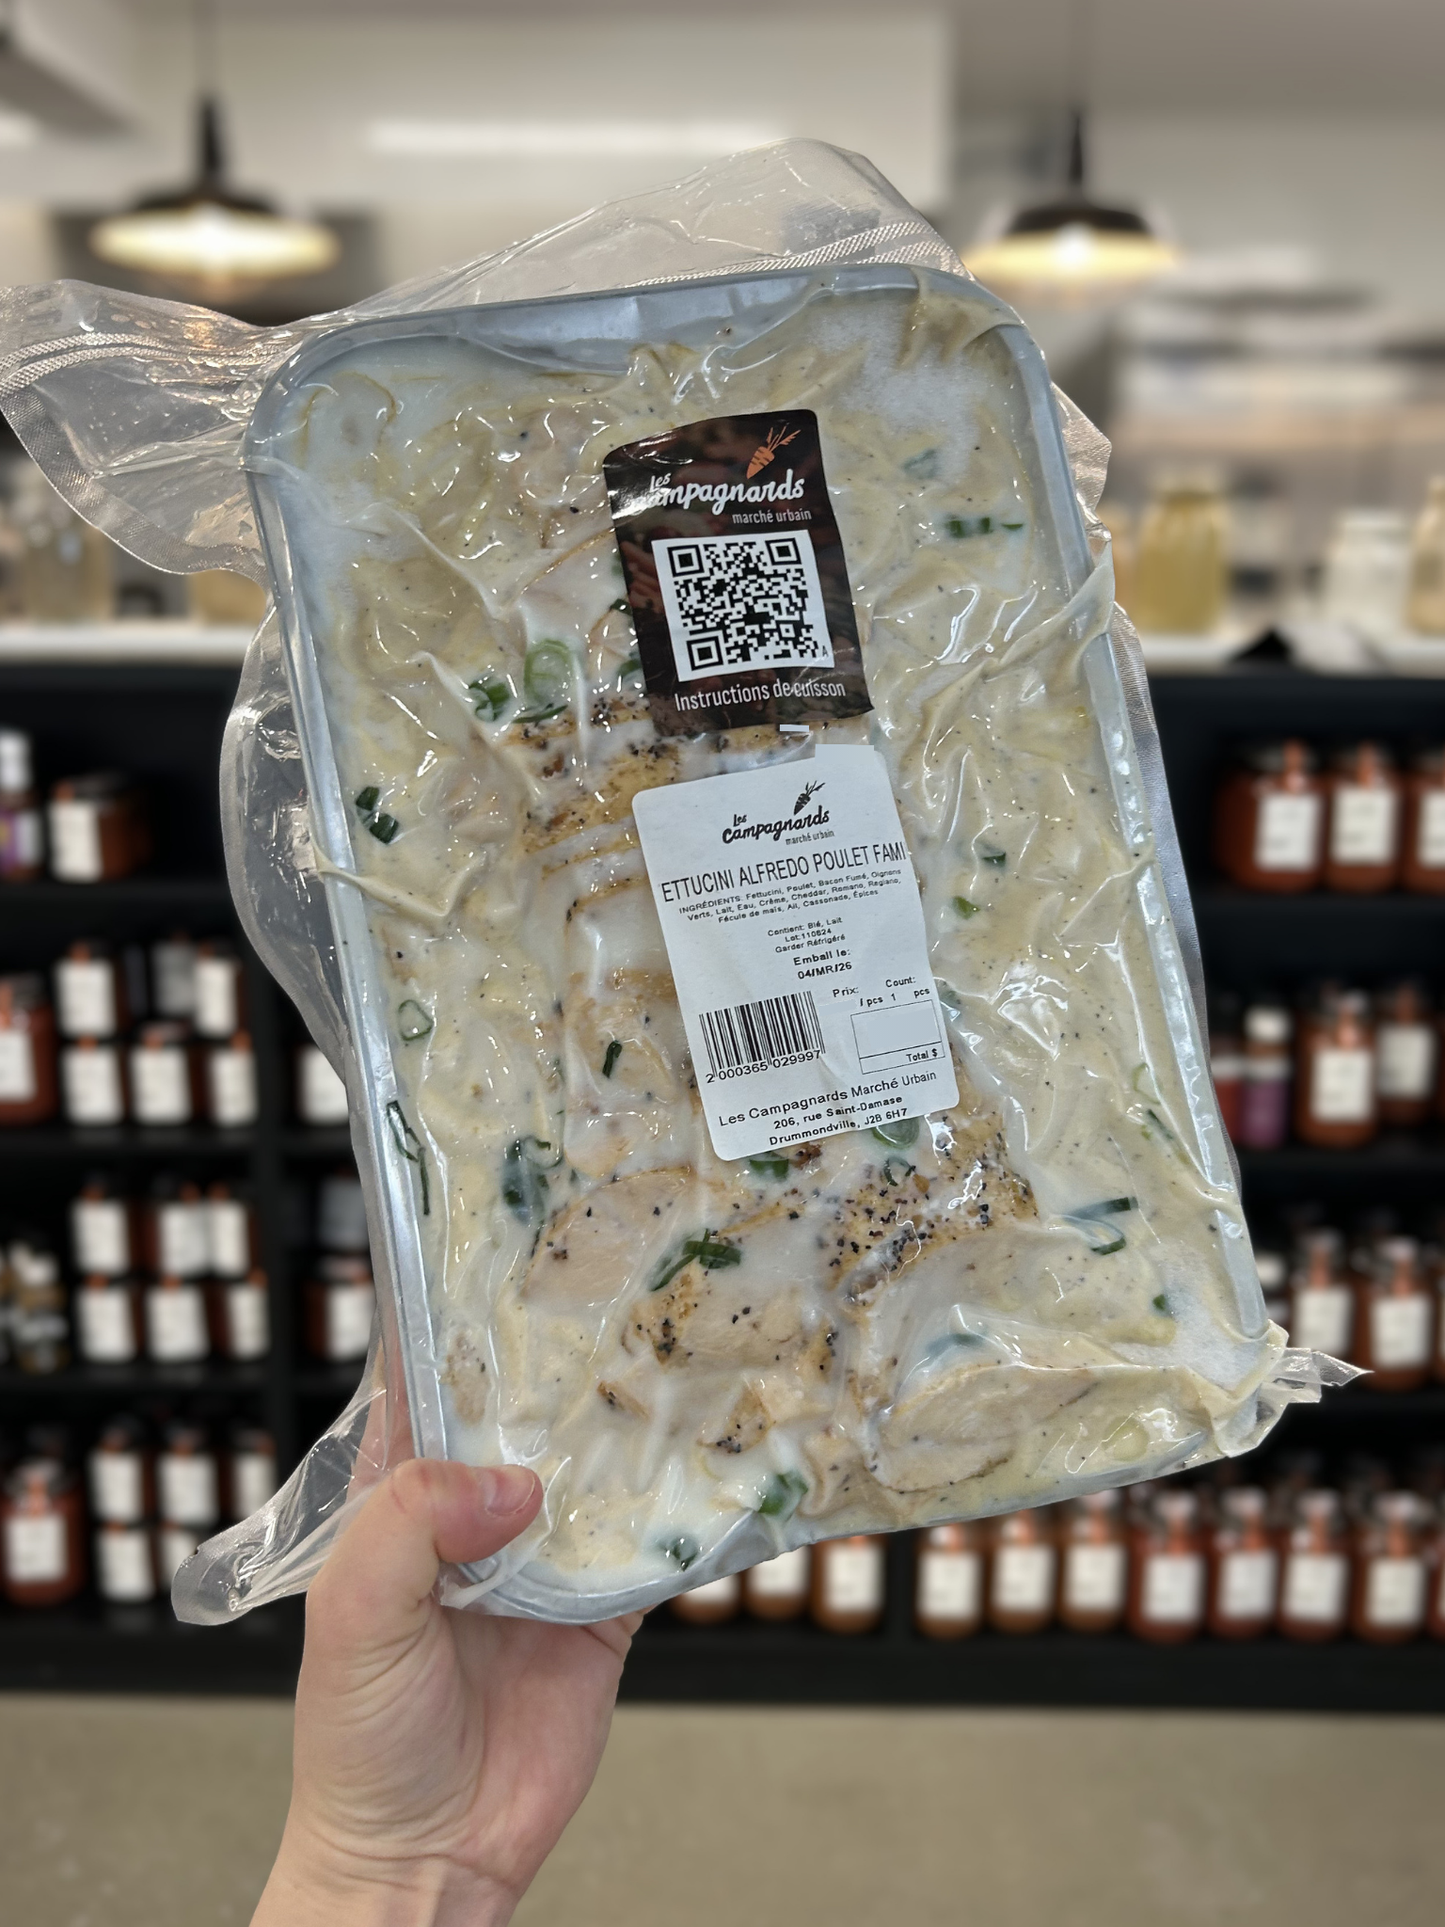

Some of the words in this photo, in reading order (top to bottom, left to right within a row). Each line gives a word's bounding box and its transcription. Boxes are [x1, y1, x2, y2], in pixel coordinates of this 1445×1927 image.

[630, 468, 805, 516] ampagnards
[650, 473, 671, 492] Les
[732, 509, 772, 524] marché
[776, 508, 812, 523] urbain
[674, 683, 770, 712] Instructions
[773, 678, 792, 698] de
[794, 678, 847, 698] cuisson
[722, 805, 830, 844] Campagnards
[733, 814, 747, 827] Les
[785, 832, 812, 845] marché
[812, 829, 835, 840] urbain
[740, 856, 809, 887] ALFREDO
[812, 846, 869, 873] POULET
[872, 841, 907, 864] FAMI
[746, 888, 784, 900] Fettucini,
[787, 882, 816, 892] Poulet,
[818, 877, 844, 887] Bacon
[846, 873, 869, 882] Fumé,
[871, 869, 902, 878] Oignons
[687, 911, 713, 921] Verts,
[716, 906, 734, 915] Lait,
[737, 903, 756, 911] Eau,
[759, 896, 789, 907] Crème,
[791, 889, 829, 901] Cheddar,
[832, 882, 866, 893] Romano,
[868, 878, 901, 888] Regiano,
[718, 912, 747, 923] Fécule
[749, 910, 760, 918] de
[803, 893, 851, 907] Cassonade,
[853, 890, 879, 899] Épices
[767, 924, 805, 937] Contient:
[826, 917, 843, 926] Lait
[775, 942, 805, 953] Garder
[807, 934, 846, 948] Réfrigéré
[793, 951, 833, 966] Emball
[797, 961, 853, 979] 04/MR/26
[885, 976, 916, 988] Count:
[832, 986, 859, 998] Prix:
[866, 996, 884, 1007] pcs
[913, 988, 930, 999] pcs
[905, 1050, 930, 1062] Total
[931, 1048, 938, 1058] $
[705, 1073, 715, 1084] 2
[718, 1061, 768, 1081] 000365
[772, 1049, 821, 1069] 029997
[719, 1113, 746, 1127] Les
[749, 1090, 848, 1119] Campagnards
[851, 1078, 899, 1098] Marché
[901, 1070, 937, 1087] Urbain
[773, 1117, 800, 1130] 206,
[803, 1112, 822, 1123] rue
[826, 1096, 903, 1117] Saint-Damase
[769, 1121, 861, 1145] Drummondville,
[864, 1114, 883, 1125] J2B
[885, 1108, 908, 1120] 6H7
